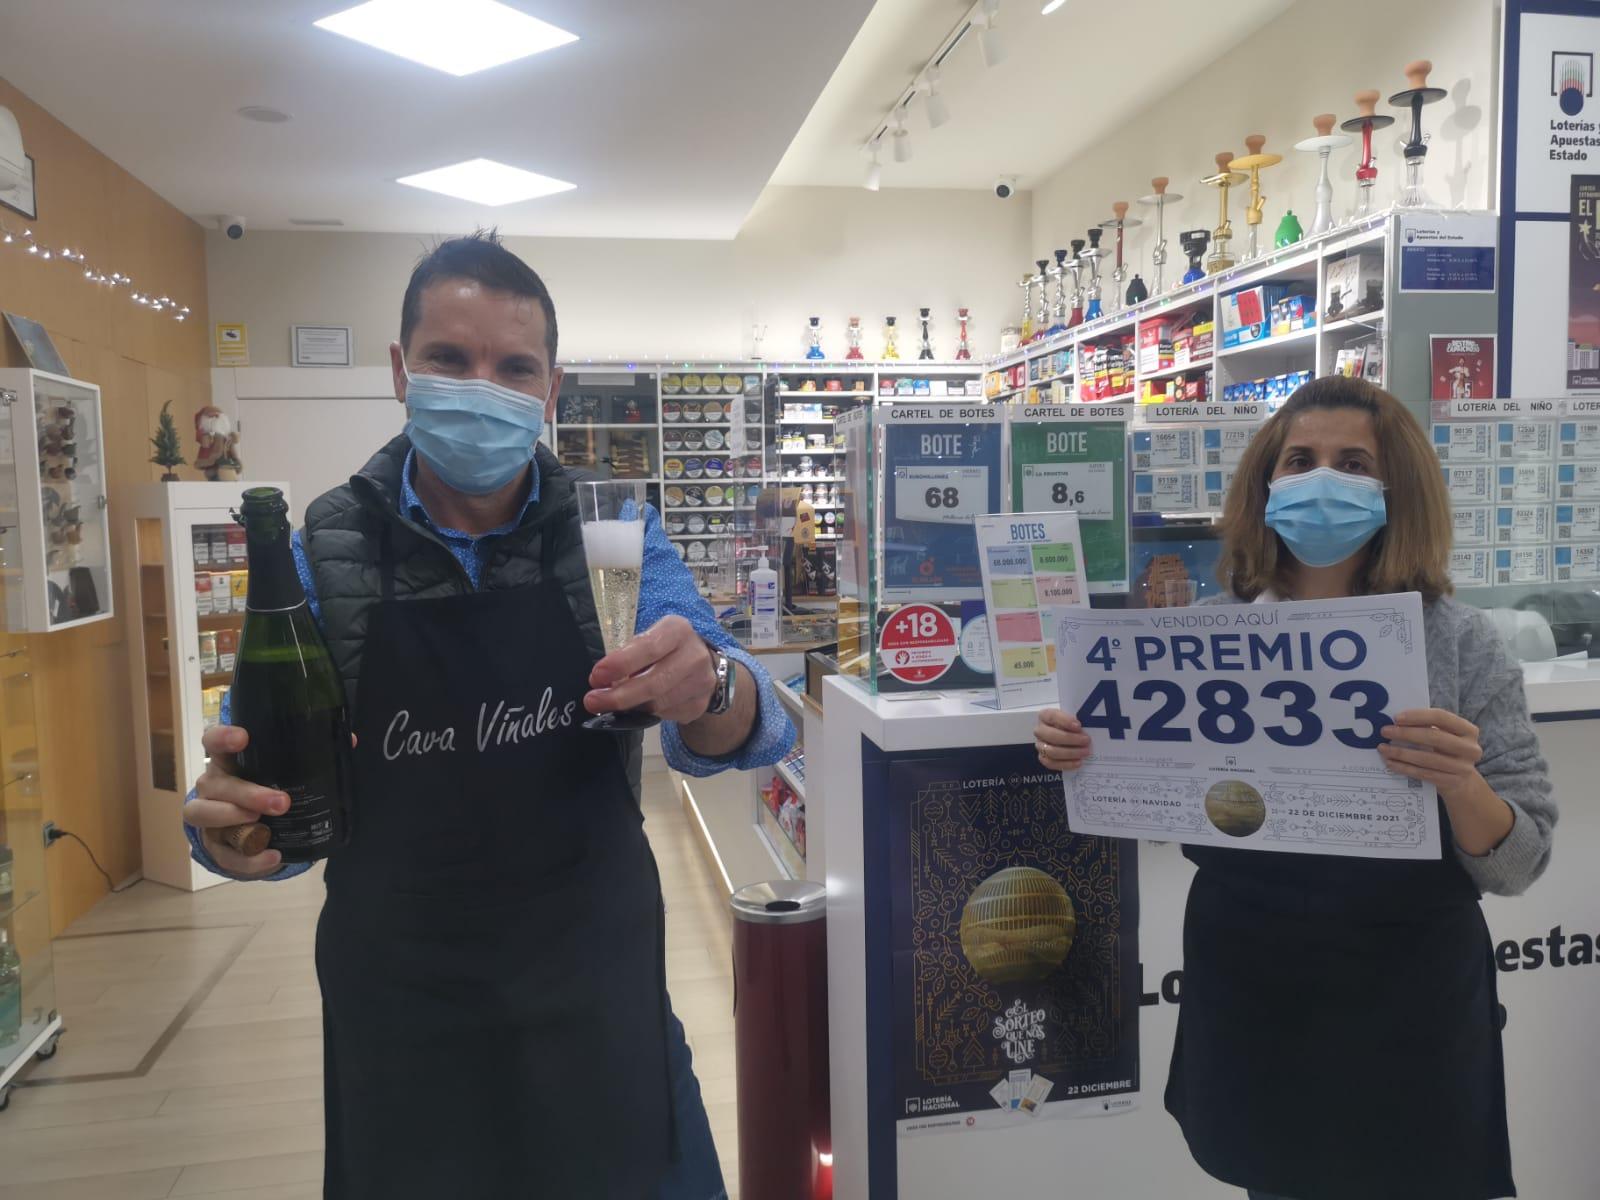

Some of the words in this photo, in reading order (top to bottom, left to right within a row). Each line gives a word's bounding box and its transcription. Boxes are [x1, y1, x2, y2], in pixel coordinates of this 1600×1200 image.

[1550, 134, 1600, 148] Apuestas
[1549, 149, 1588, 161] Estado
[1579, 199, 1593, 217] EL
[891, 409, 933, 419] CARTEL
[939, 409, 954, 418] DE
[960, 408, 995, 418] BOTES
[1024, 407, 1065, 417] CARTEL
[1070, 407, 1085, 417] DE
[1090, 407, 1125, 417] BOTES
[1156, 405, 1199, 416] LOTERÍA
[1206, 406, 1225, 415] DEL
[1233, 404, 1258, 414] NIÑO
[1457, 402, 1497, 412] LOTERÍA
[1503, 402, 1521, 412] DEL
[1530, 400, 1553, 411] NIÑO
[1573, 402, 1600, 411] LOTER
[921, 434, 962, 455] BOTE
[1047, 431, 1088, 453] BOTE
[924, 486, 959, 508] 68
[1051, 482, 1085, 506] 8,6
[1010, 523, 1046, 540] BOTES
[895, 612, 938, 638] +18
[1150, 613, 1229, 629] VENDIDO
[1233, 609, 1280, 627] AQUÍ
[1134, 629, 1368, 672] PREMIO
[1076, 679, 1396, 750] 42833
[383, 709, 456, 761] Cava
[476, 686, 576, 752] Viñales
[962, 776, 1006, 789] LOTERÍA
[1023, 774, 1062, 784] NAVIDA
[1092, 795, 1127, 804] LOTERÍA
[1142, 799, 1182, 808] NAVIDAD
[1288, 808, 1299, 816] 22
[1318, 811, 1373, 821] DICIEMBRE
[1376, 814, 1400, 822] 2021
[992, 1009, 1046, 1039] SORTEO
[1081, 1080, 1132, 1093] DICIEMBRE
[922, 1101, 960, 1111] NACIONAL
